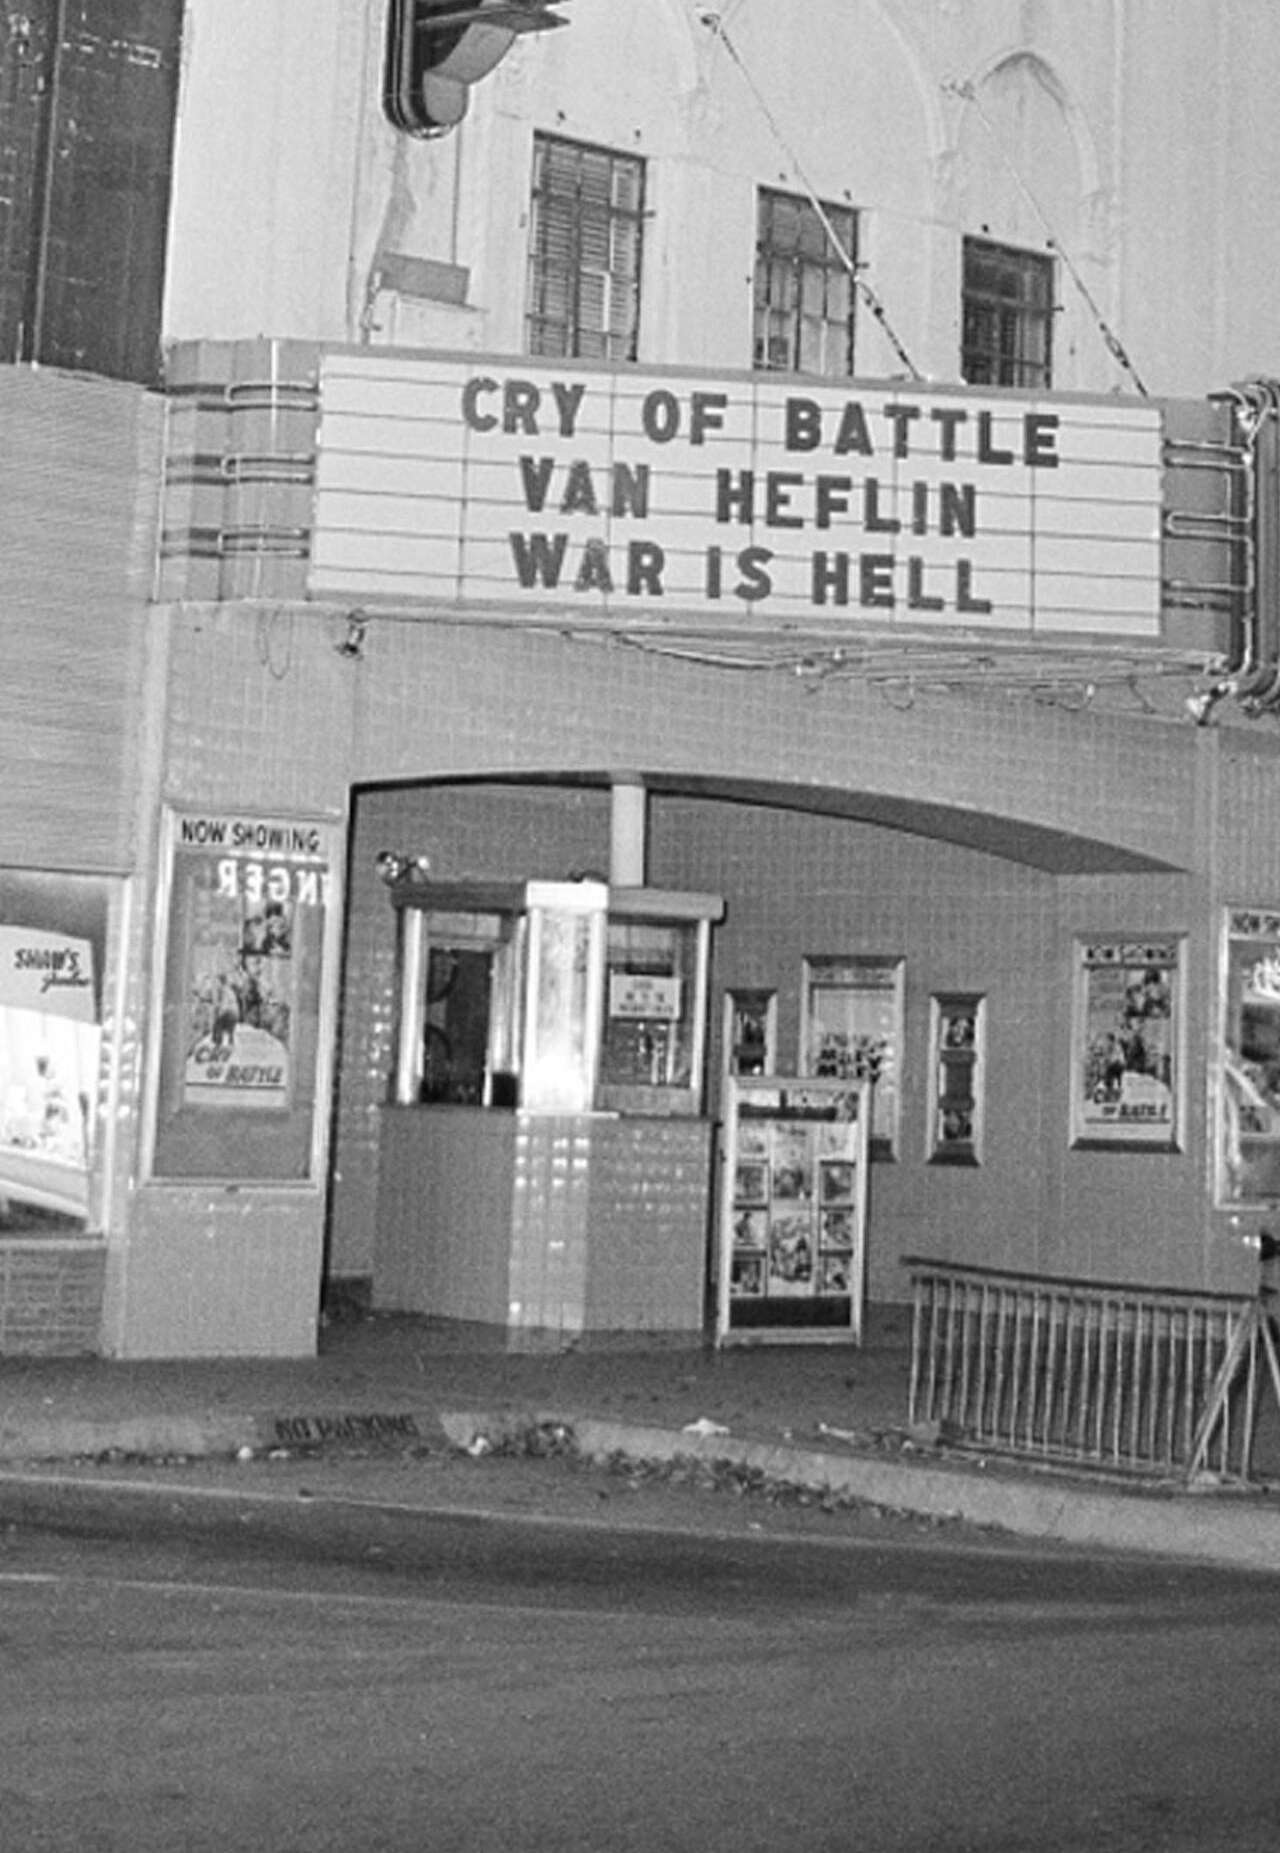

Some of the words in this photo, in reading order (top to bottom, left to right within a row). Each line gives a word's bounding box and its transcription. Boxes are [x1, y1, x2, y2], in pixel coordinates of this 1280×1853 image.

[462, 377, 586, 438] CRY
[642, 389, 728, 446] OF
[786, 397, 1060, 468] BATTLE
[519, 455, 650, 519] VAN
[716, 468, 976, 538] HEFLIN
[509, 532, 665, 597] WAR
[706, 546, 774, 602] IS
[812, 551, 992, 615] HELL
[182, 819, 226, 844] NOW
[231, 822, 320, 853] SHOWING
